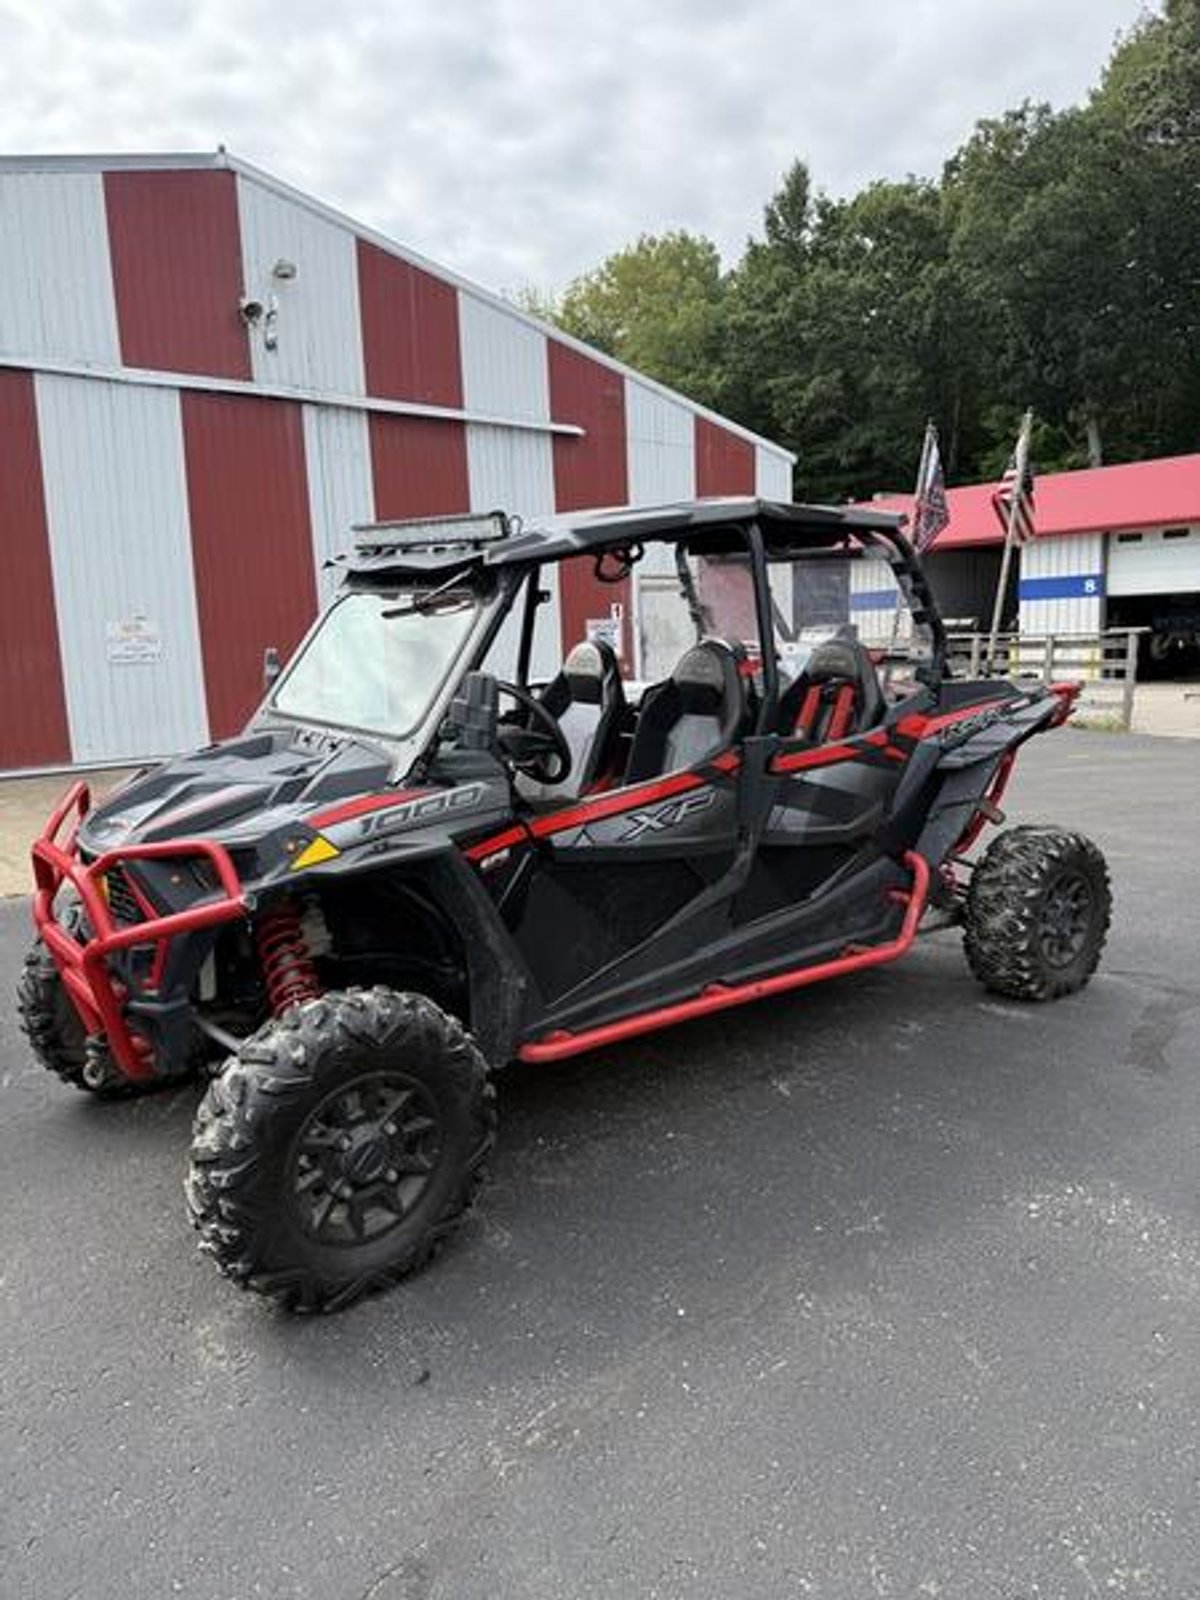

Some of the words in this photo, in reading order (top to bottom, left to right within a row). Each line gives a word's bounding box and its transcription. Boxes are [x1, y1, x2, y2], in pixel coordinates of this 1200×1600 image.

[1084, 578, 1096, 594] 8
[360, 782, 484, 837] 1000
[616, 791, 718, 844] XP
